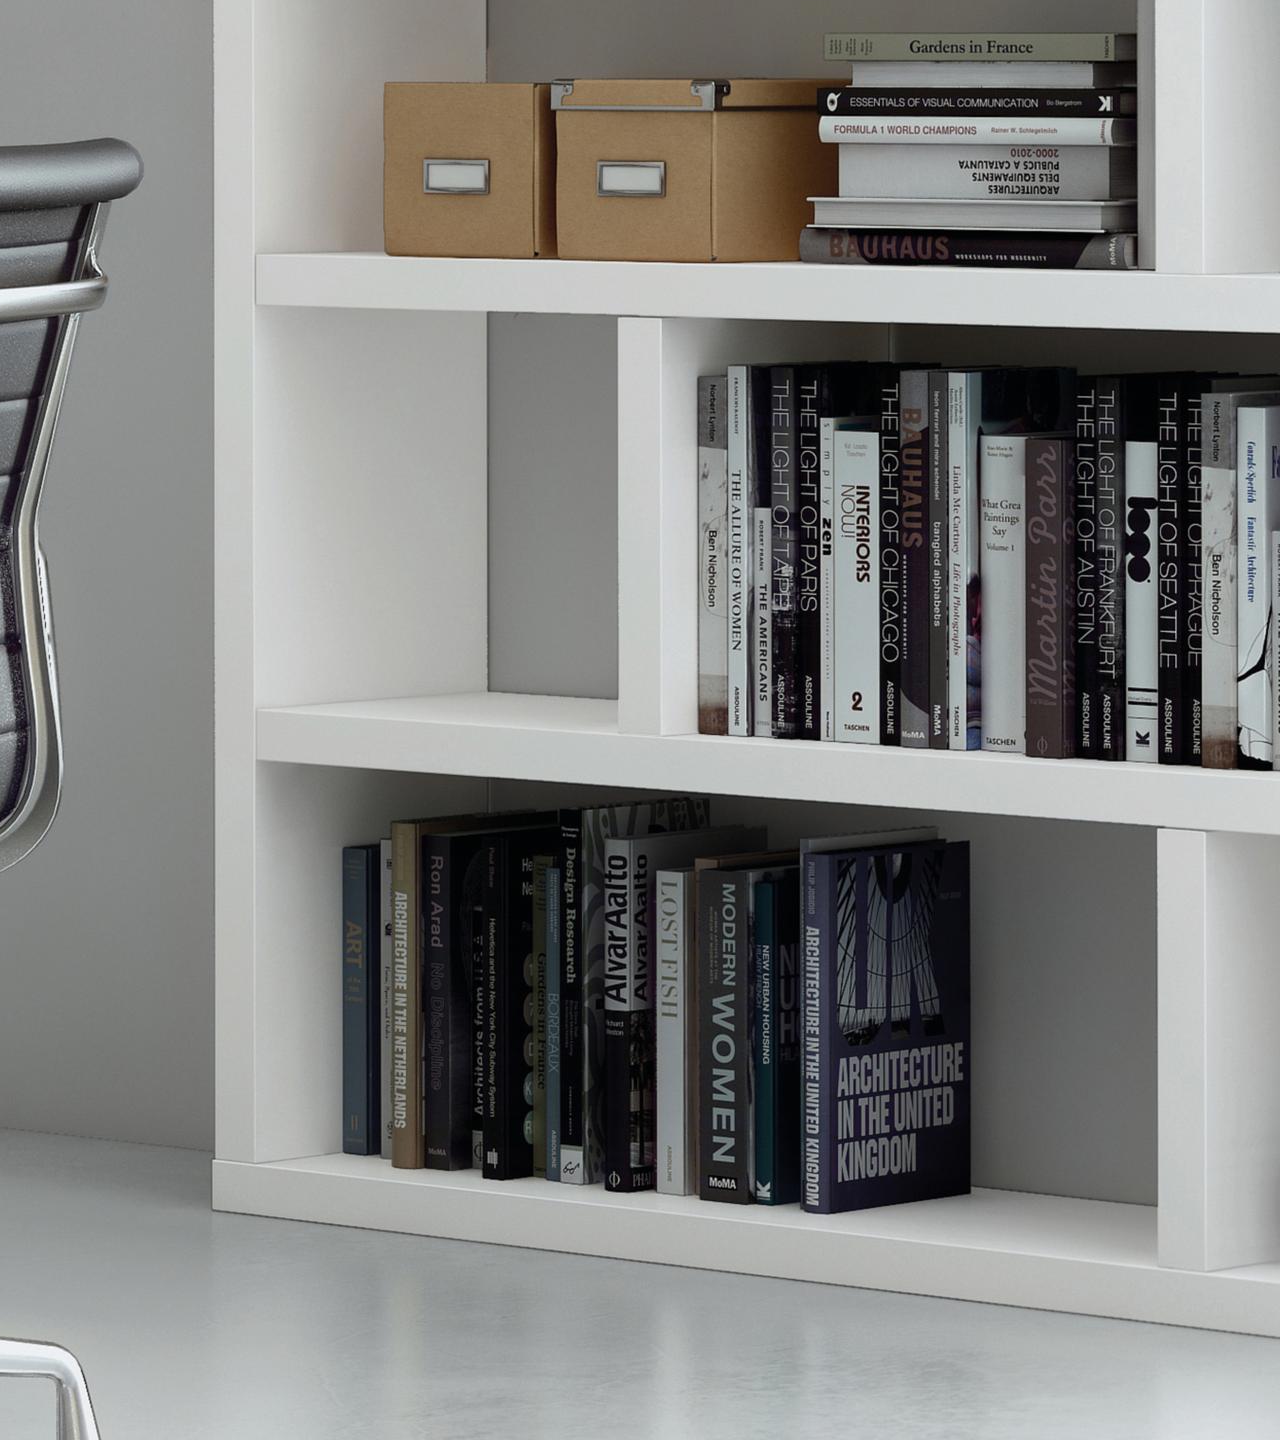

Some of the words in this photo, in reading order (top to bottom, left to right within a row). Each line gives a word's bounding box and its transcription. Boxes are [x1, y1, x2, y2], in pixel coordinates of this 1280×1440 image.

[909, 39, 965, 53] Gardens
[969, 40, 982, 53] in
[986, 40, 1033, 53] France
[849, 97, 905, 107] ESSENTIALS
[907, 97, 920, 107] OF
[921, 97, 954, 107] VISUAL
[956, 97, 1038, 107] COMMUNICATION
[833, 124, 877, 134] FORMULA
[886, 125, 920, 134] WORLD
[922, 125, 976, 135] CHAMPIONS
[1010, 148, 1059, 157] 2000-2010
[958, 160, 1010, 169] CATALUNYA
[972, 172, 1035, 182] EQUIPAMENTS
[1013, 160, 1020, 169] A
[1038, 173, 1059, 182] DELS
[988, 185, 1059, 195] ARQUITECTURES
[829, 235, 950, 260] BAUHAUS
[881, 383, 898, 430] THE
[1159, 392, 1176, 441] THE
[881, 436, 898, 505] LIGHT
[1159, 447, 1177, 518] LIGHT
[841, 484, 856, 538] NOW!
[1028, 445, 1057, 545] Parr
[708, 530, 717, 550] Ben
[822, 517, 832, 556] zen
[856, 484, 870, 583] INTERIORS
[881, 509, 898, 542] OF
[1159, 522, 1177, 556] OF
[708, 554, 716, 607] Nicholson
[881, 548, 899, 662] CHICAGO
[1159, 561, 1177, 668] SEATTLE
[1029, 555, 1057, 708] Martin
[851, 691, 863, 712] 2
[844, 723, 870, 732] TASCHEN
[394, 891, 407, 989] ARCHITECTURE
[660, 881, 677, 951] LOST
[722, 883, 735, 985] MODERN
[394, 993, 406, 1006] IN
[661, 959, 677, 1017] FISH
[806, 926, 819, 1034] ARCHITECTURE
[394, 1008, 406, 1033] THE
[806, 1037, 819, 1052] IN
[394, 1036, 406, 1128] NETHERLANDS
[711, 993, 735, 1162] WOMEN
[806, 1053, 819, 1080] THE
[837, 1043, 963, 1098] ARCHITECTURE
[806, 1082, 819, 1134] UNITED
[838, 1101, 853, 1140] IN
[857, 1096, 890, 1136] THE
[894, 1087, 954, 1129] UNITED
[806, 1137, 819, 1206] KINGDOM
[837, 1133, 917, 1183] KINGDOM
[709, 1177, 736, 1190] MoMA
